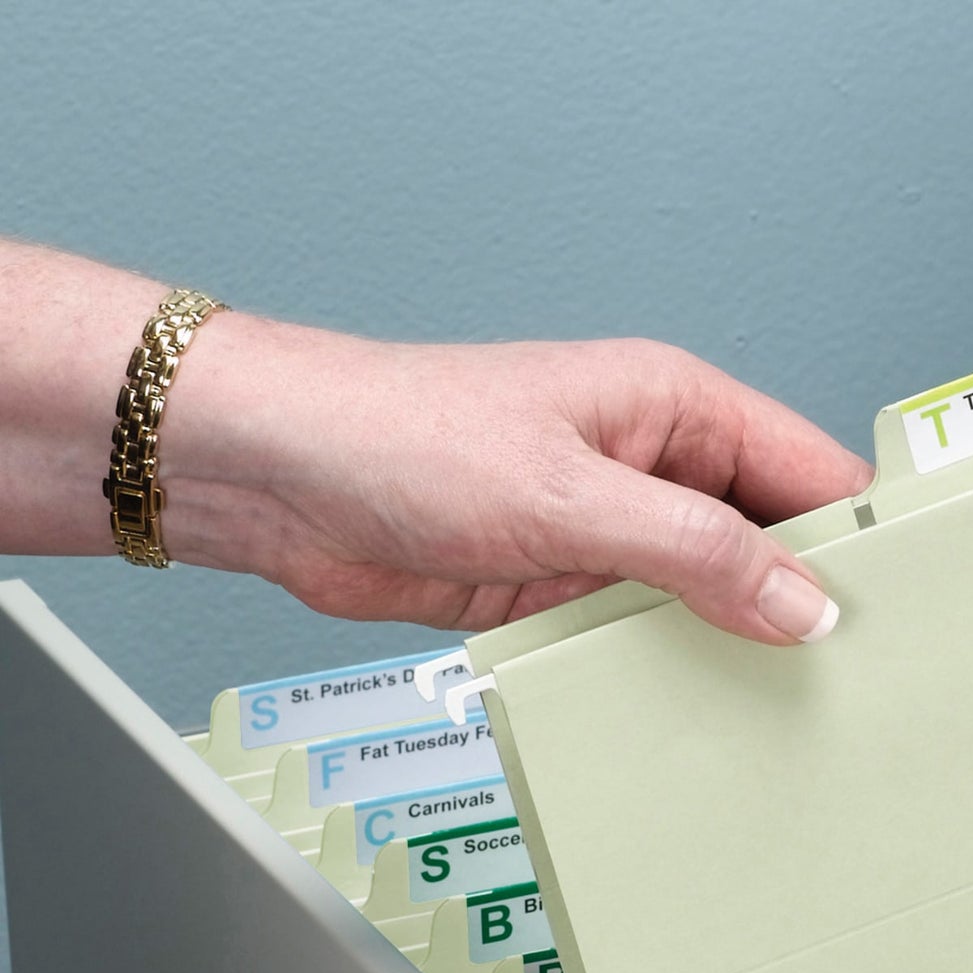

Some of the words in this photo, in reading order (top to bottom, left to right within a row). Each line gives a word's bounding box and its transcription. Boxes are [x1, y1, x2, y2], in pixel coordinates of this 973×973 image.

[920, 403, 951, 448] T
[291, 688, 314, 704] St.
[320, 672, 397, 698] Patrick's
[251, 695, 279, 731] S
[360, 746, 390, 761] Fat
[394, 731, 470, 755] Tuesday
[321, 751, 346, 790] F
[408, 791, 495, 818] Carnivals
[364, 809, 396, 846] C
[464, 834, 525, 854] Socce
[420, 845, 451, 883] S
[480, 905, 513, 945] B
